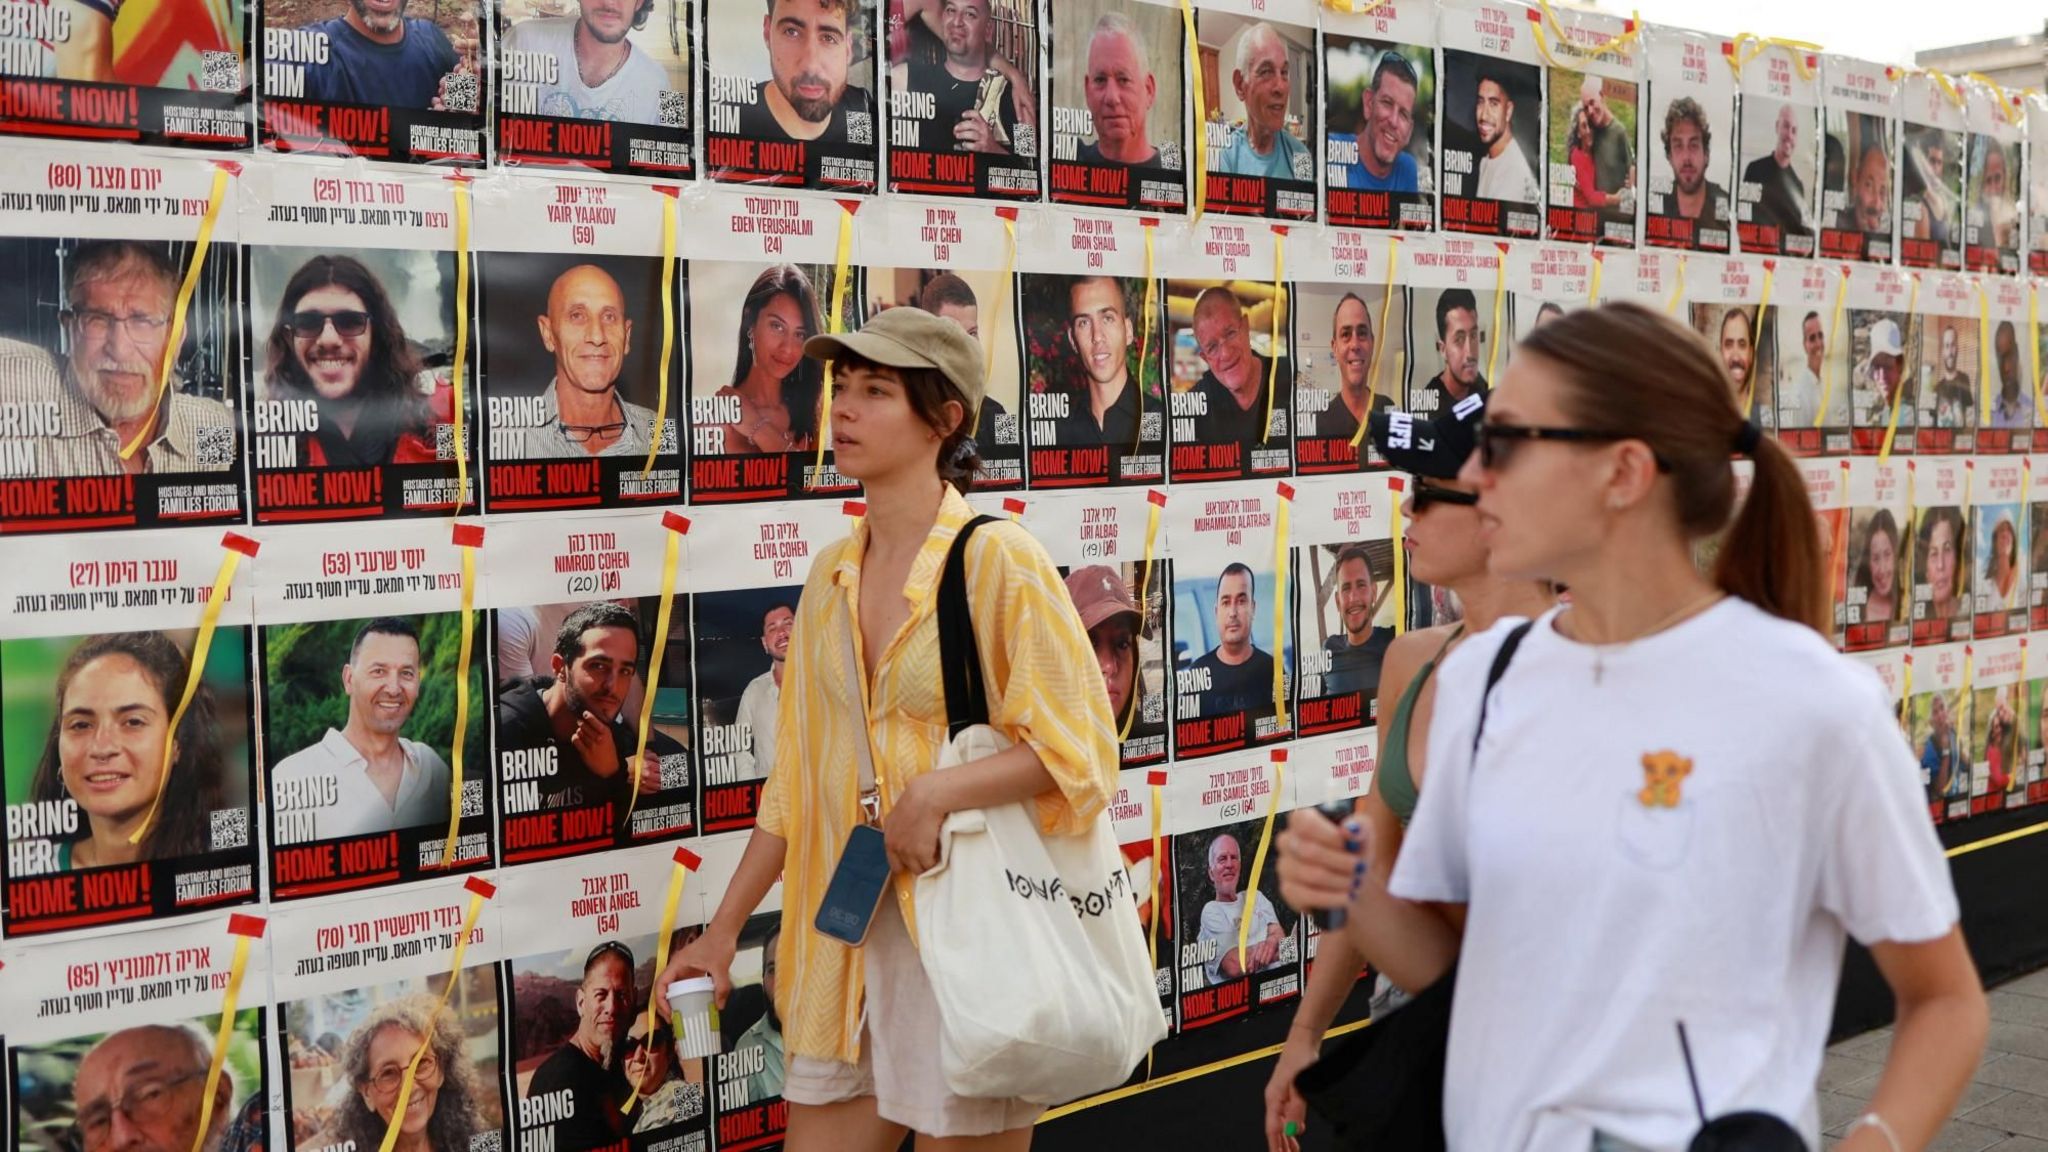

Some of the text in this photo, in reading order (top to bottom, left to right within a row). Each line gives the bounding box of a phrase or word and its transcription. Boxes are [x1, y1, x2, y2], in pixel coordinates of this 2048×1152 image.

[0, 1, 70, 42] BRING
[0, 41, 43, 77] HIM
[264, 27, 329, 64] BRING
[264, 62, 305, 98] HIM
[502, 52, 559, 85] BRING
[0, 82, 138, 126] HOME NOW!
[502, 83, 540, 117] HIM
[711, 77, 758, 105] BRING
[164, 105, 199, 119] HOSTAGES
[200, 109, 215, 121] AND
[165, 117, 246, 138] FAMILIES FORUM
[263, 101, 389, 143] HOME NOW!
[709, 103, 741, 134] HIM
[1052, 106, 1093, 136] BRING
[1052, 134, 1078, 161] HIM
[1327, 140, 1359, 165] BRING
[49, 162, 82, 191] (80)
[131, 167, 162, 190] יורם
[1327, 163, 1348, 188] HIM
[313, 178, 405, 204] סהר ברוך (25)
[548, 205, 616, 225] YAIR YAAKOV
[732, 216, 813, 237] EDEN YERUSHALMI
[571, 226, 594, 246] (59)
[763, 235, 782, 254] (24)
[921, 226, 962, 244] ITAY CHEN
[1072, 234, 1117, 251] ORON SHAUL
[934, 244, 951, 262] (19)
[1087, 251, 1103, 269] (30)
[253, 399, 319, 433] BRING
[488, 396, 546, 429] BRING
[691, 395, 742, 425] BRING
[1030, 392, 1070, 419] BRING
[489, 428, 527, 460] HIM
[693, 426, 725, 456] HER
[1031, 420, 1057, 446] HIM
[255, 434, 297, 468] HIM
[1031, 445, 1109, 476] HOME NOW!
[257, 465, 384, 507] HOME NOW!
[490, 457, 601, 497] HOME NOW!
[693, 453, 788, 490] HOME NOW!
[66, 474, 135, 515] NOW!
[158, 483, 238, 501] HOSTAGES AND MISSING
[158, 493, 240, 514] FAMILIES FORUM
[1080, 523, 1119, 541] LIRI ALBAG
[1194, 513, 1270, 533] MUHAMMAD ALATRASH
[753, 540, 809, 560] ELIYA COHEN
[1082, 542, 1102, 559] (19)
[1226, 530, 1242, 547] (40)
[69, 560, 178, 589] ענבר הימן (27)
[321, 548, 426, 577] יוסי שרעבי (53)
[554, 551, 630, 574] NIMROD COHEN
[773, 558, 793, 580] (27)
[421, 575, 436, 591] על
[566, 575, 600, 596] (20)
[1176, 666, 1212, 694] BRING
[1177, 693, 1201, 721] HIM
[703, 722, 753, 755] BRING
[1176, 711, 1245, 748] HOME NOW!
[501, 746, 559, 782] BRING
[705, 752, 738, 786] HIM
[273, 775, 338, 812] BRING
[503, 780, 541, 815] HIM
[705, 786, 752, 820] HOME
[1201, 779, 1271, 807] KEITH SAMUEL SIEGEL
[7, 799, 79, 840] BRING
[505, 801, 614, 850] HOME NOW!
[1114, 802, 1144, 821] FARHAN
[1219, 803, 1242, 820] (65)
[275, 810, 317, 846] HIM
[8, 840, 54, 879] HER
[275, 831, 399, 883] HOME NOW!
[9, 861, 150, 919] HOME NOW!
[175, 865, 251, 889] HOSTAGES AND MISSING
[176, 877, 252, 902] FAMILIES FORUM
[571, 889, 641, 919] RONEN ANGEL
[315, 924, 345, 954] (70)
[596, 912, 620, 936] (54)
[176, 946, 212, 974] אריה
[1182, 938, 1217, 969] BRING
[66, 961, 101, 995] (85)
[1182, 963, 1205, 993] HIM
[1182, 976, 1250, 1021] HOME NOW!
[717, 1044, 764, 1083] BRING
[517, 1088, 575, 1130] BRING
[718, 1077, 750, 1113] HIM
[520, 1124, 556, 1152] HIM
[719, 1105, 764, 1146] HOME
